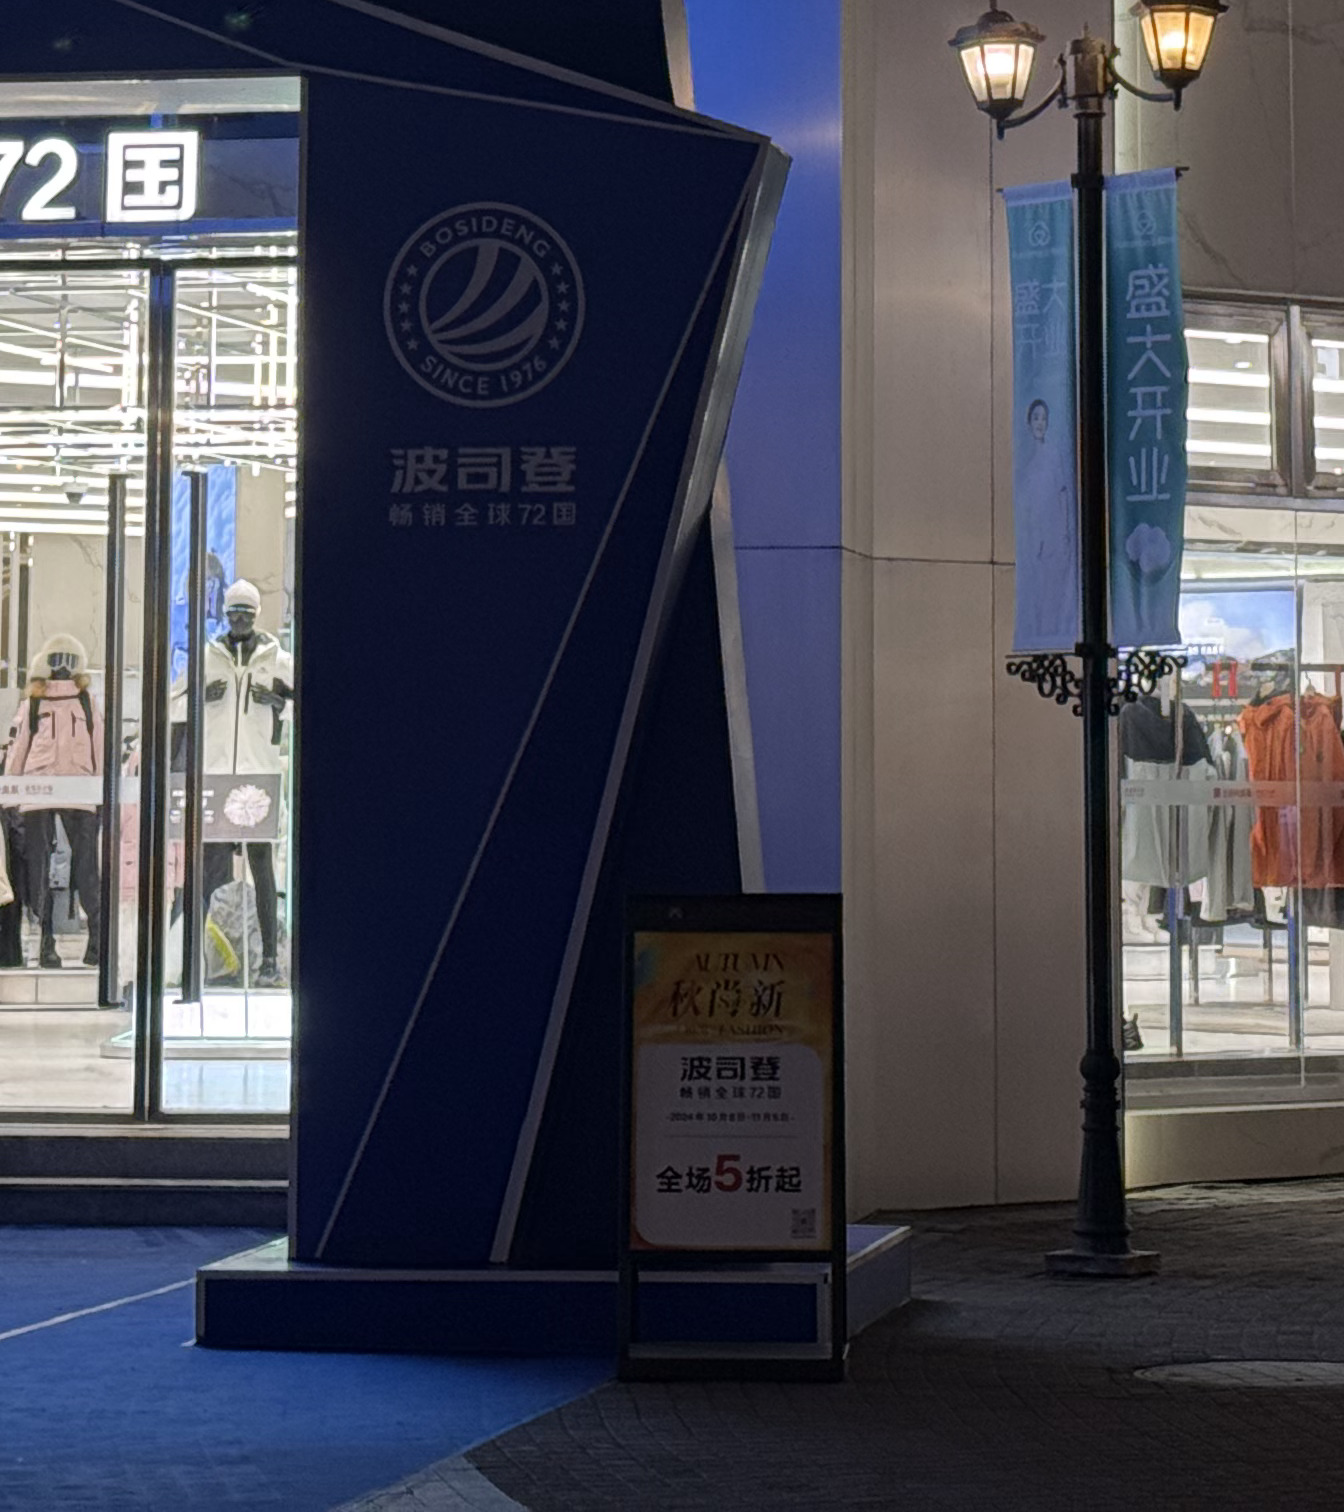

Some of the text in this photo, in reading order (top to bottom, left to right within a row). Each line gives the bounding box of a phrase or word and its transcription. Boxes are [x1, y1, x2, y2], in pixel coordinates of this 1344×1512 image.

[419, 214, 552, 260] BOSIDENG
[1015, 278, 1067, 316] 盛大
[419, 353, 549, 395] SINCE 1976
[1125, 261, 1173, 503] 盛大开业
[388, 445, 578, 494] 波司登
[388, 502, 577, 528] 畅销全球72国
[680, 1055, 781, 1083] 波司登
[656, 1153, 802, 1194] 全场5折起
